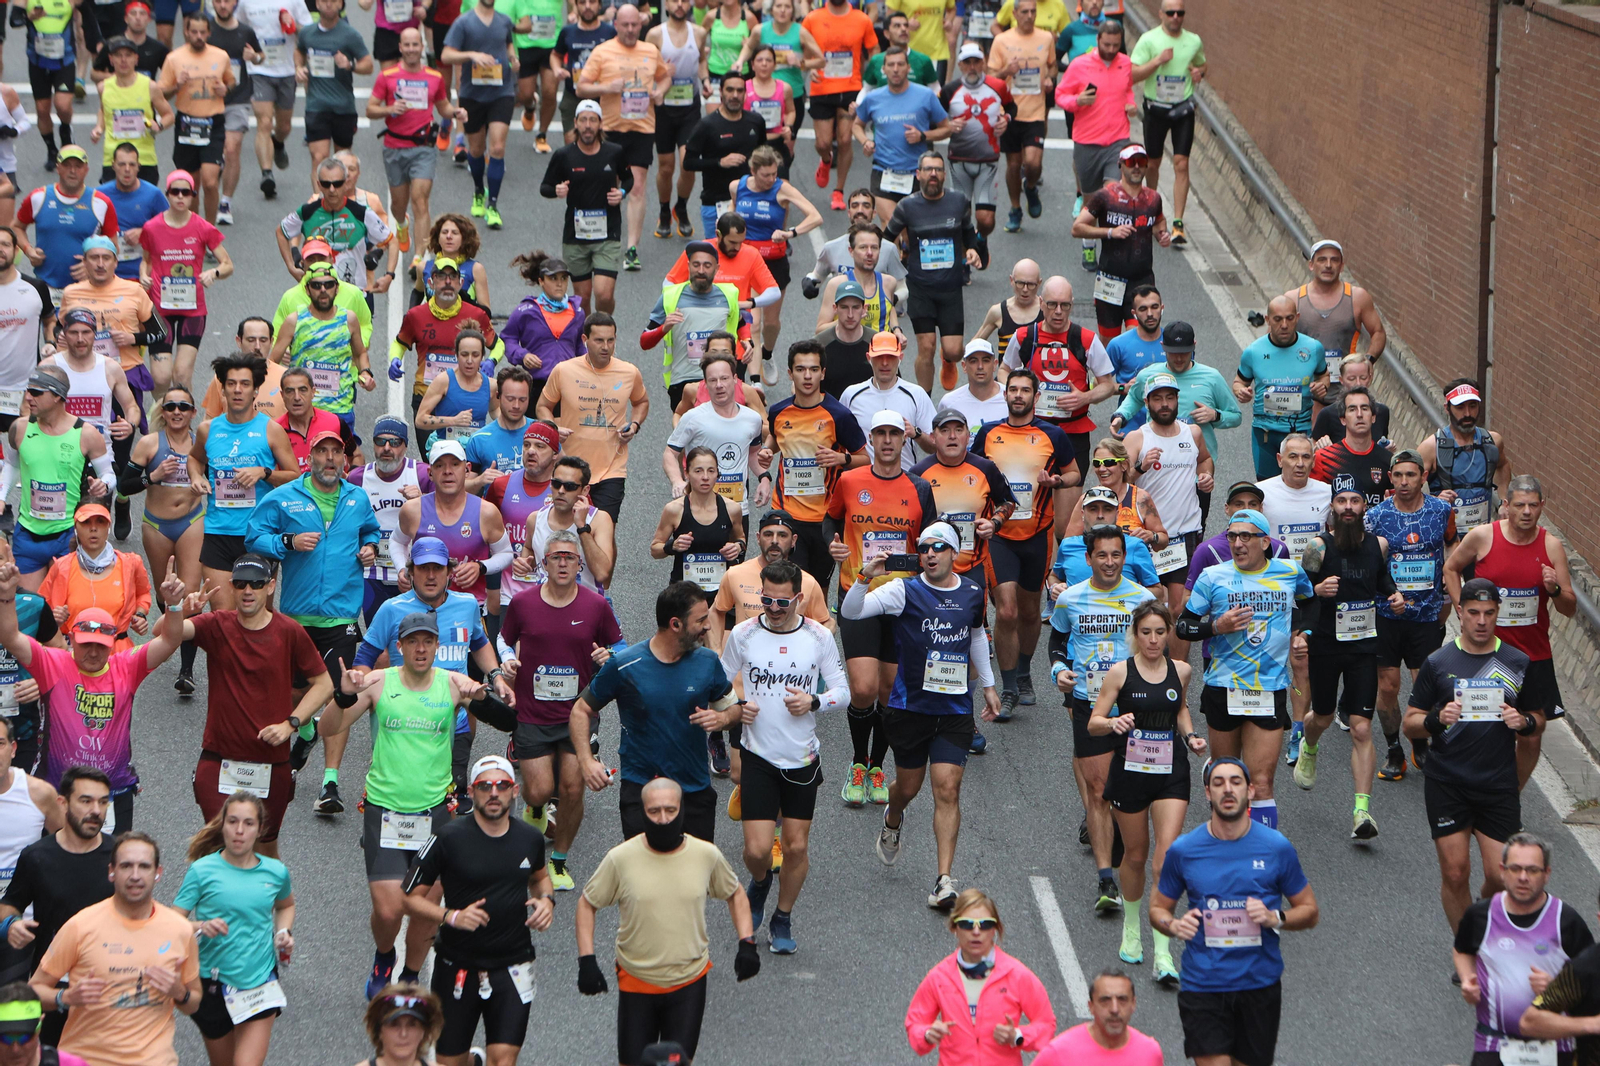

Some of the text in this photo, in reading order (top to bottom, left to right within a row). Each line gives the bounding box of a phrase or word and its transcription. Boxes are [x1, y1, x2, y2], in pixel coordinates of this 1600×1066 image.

[422, 329, 436, 340] 78
[315, 362, 339, 371] ZURICH
[1048, 383, 1070, 391] ZURICH
[70, 403, 97, 411] LIVER
[70, 409, 97, 417] TRUST
[851, 514, 916, 528] CDA CAMAS
[1292, 524, 1317, 532] ZURICH
[877, 532, 902, 540] ZURICH
[697, 554, 722, 562] ZURICH
[1159, 549, 1174, 559] 9300
[1227, 591, 1287, 603] DEPORTIVO
[1511, 589, 1535, 597] ZURICH
[1509, 601, 1526, 609] 9725
[1078, 613, 1132, 625] DEPORTIVO
[1350, 615, 1366, 623] 8229
[921, 616, 953, 633] Palma
[942, 654, 965, 663] ZURICH
[548, 667, 575, 675] ZURICH
[940, 667, 956, 675] 8817
[749, 665, 814, 694] Germany
[547, 680, 564, 688] 9624
[385, 715, 402, 729] Las
[1144, 732, 1169, 741] ZURICH
[1142, 746, 1160, 754] 7816
